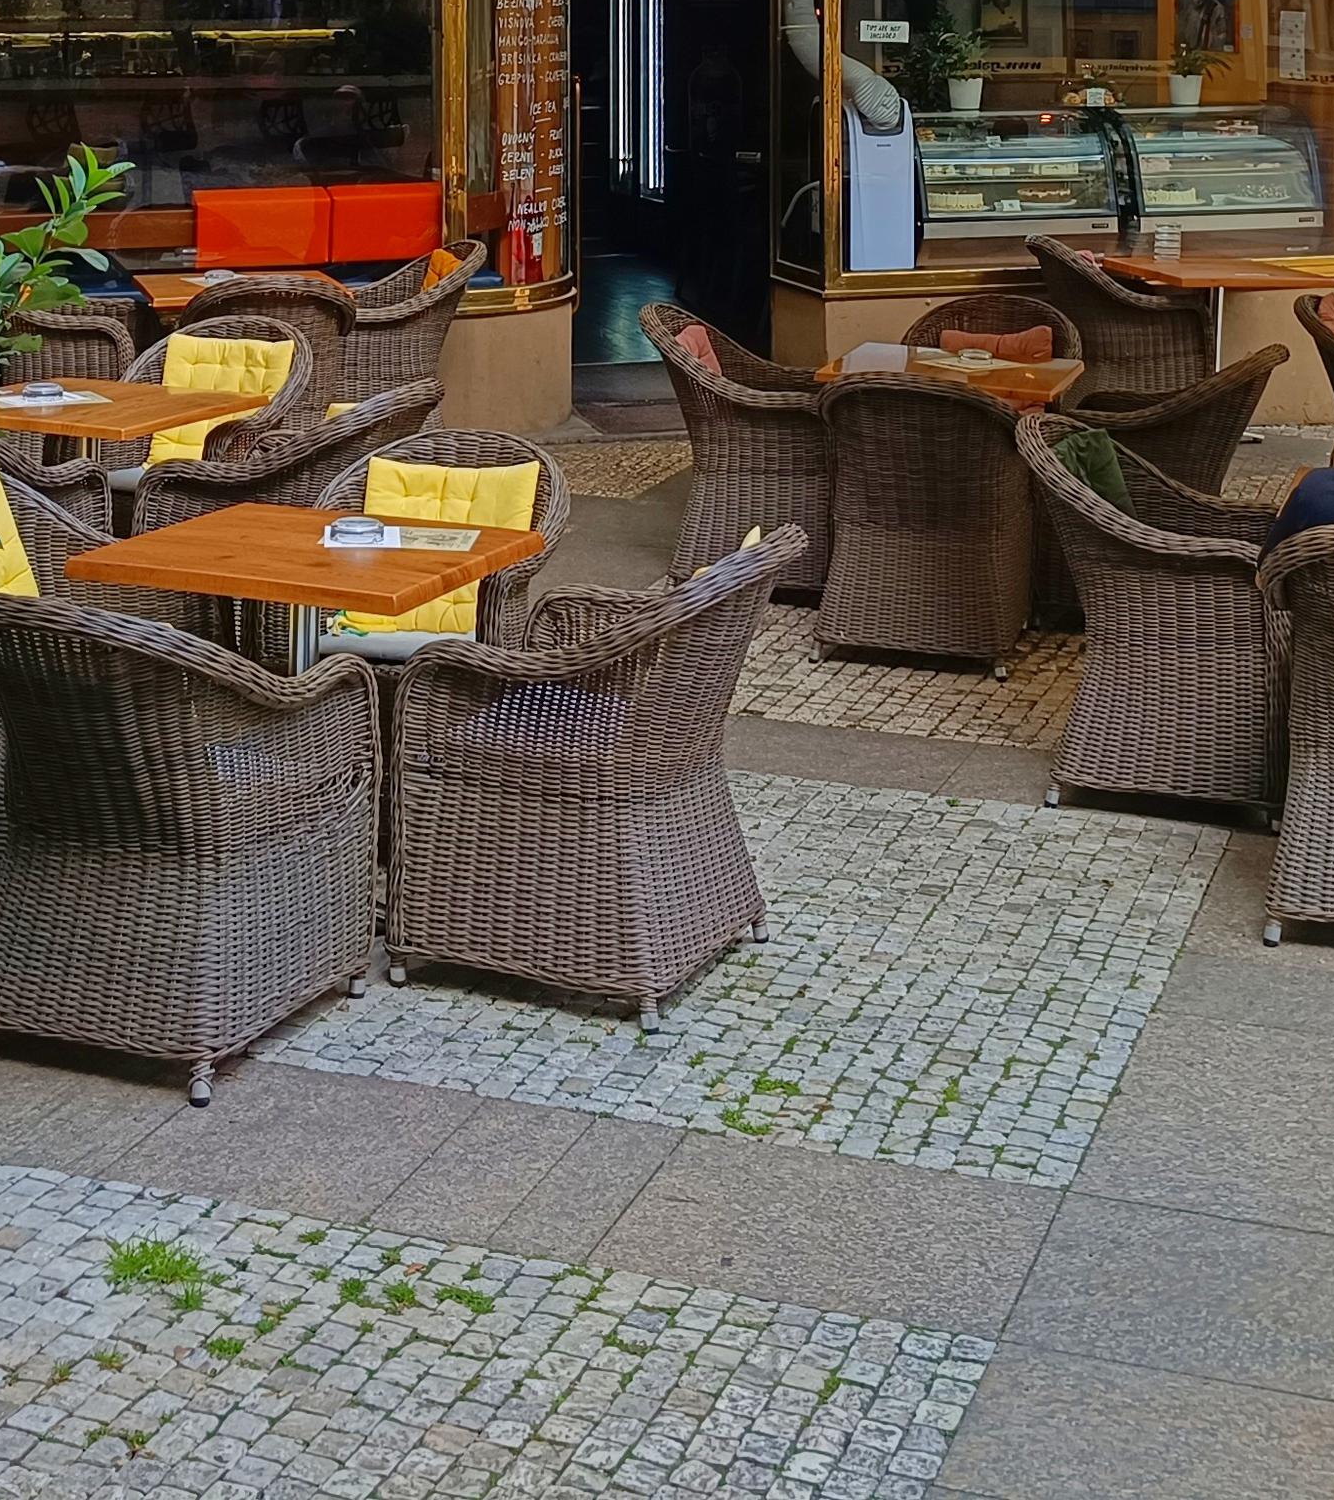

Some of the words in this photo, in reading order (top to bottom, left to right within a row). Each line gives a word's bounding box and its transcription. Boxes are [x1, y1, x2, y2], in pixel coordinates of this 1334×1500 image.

[529, 101, 543, 116] ICE
[545, 100, 557, 114] TEA
[501, 127, 536, 146] OVOCNÝ
